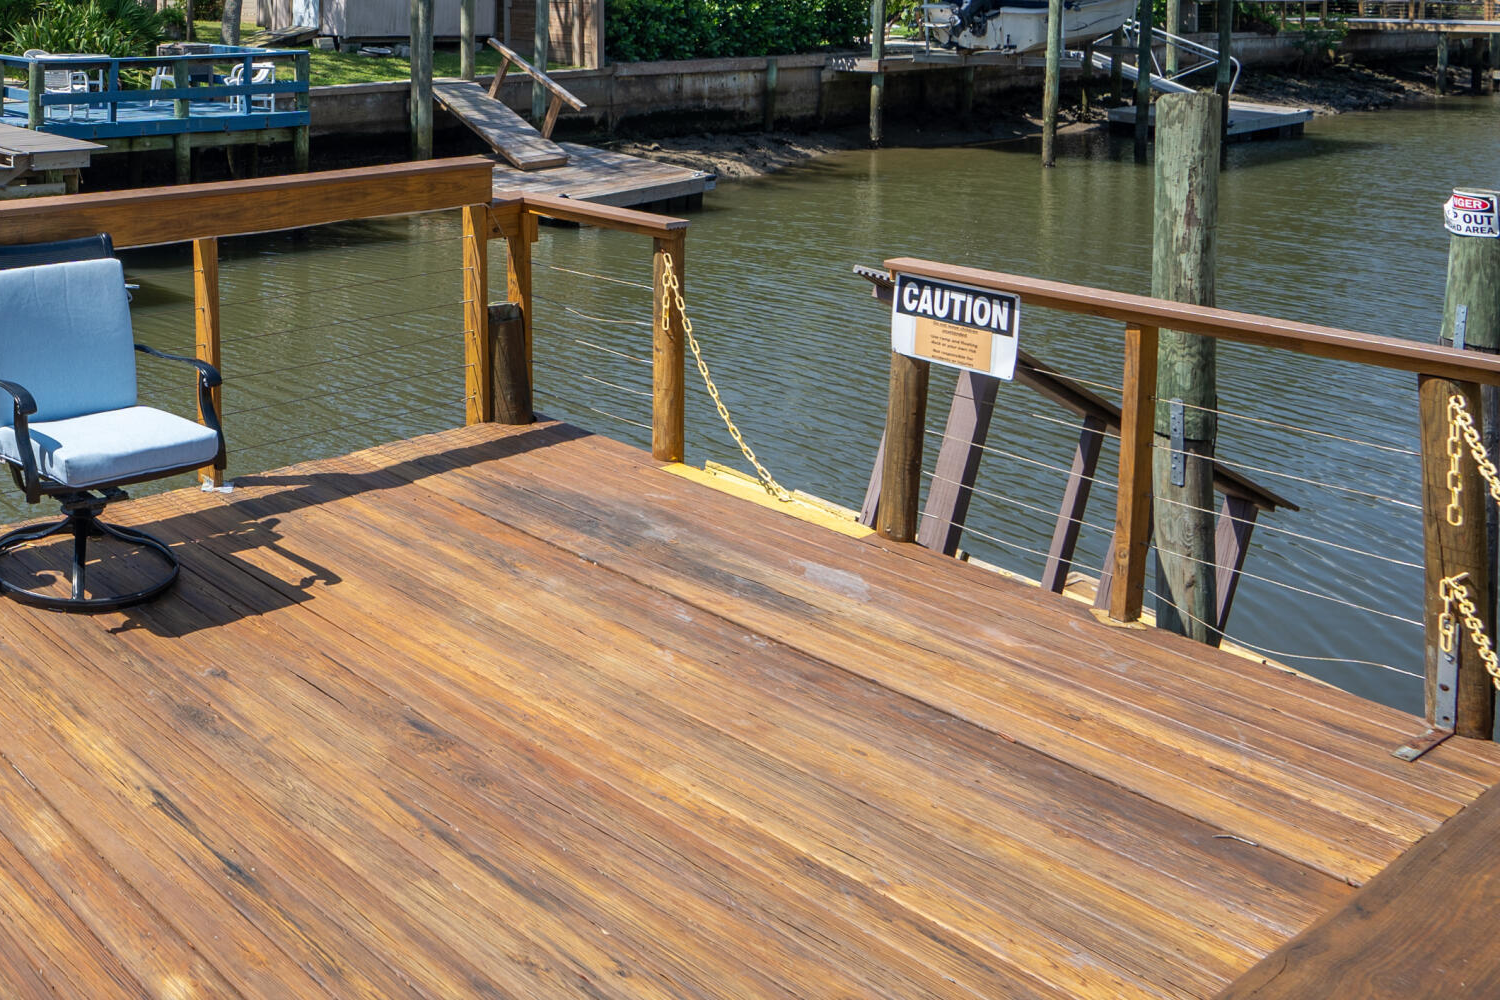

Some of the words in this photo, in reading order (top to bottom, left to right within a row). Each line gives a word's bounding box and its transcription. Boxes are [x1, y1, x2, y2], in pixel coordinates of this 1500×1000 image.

[1453, 197, 1482, 209] NGER
[1463, 213, 1494, 225] OUT
[1465, 225, 1495, 234] AREA
[903, 281, 1009, 331] CAUTION
